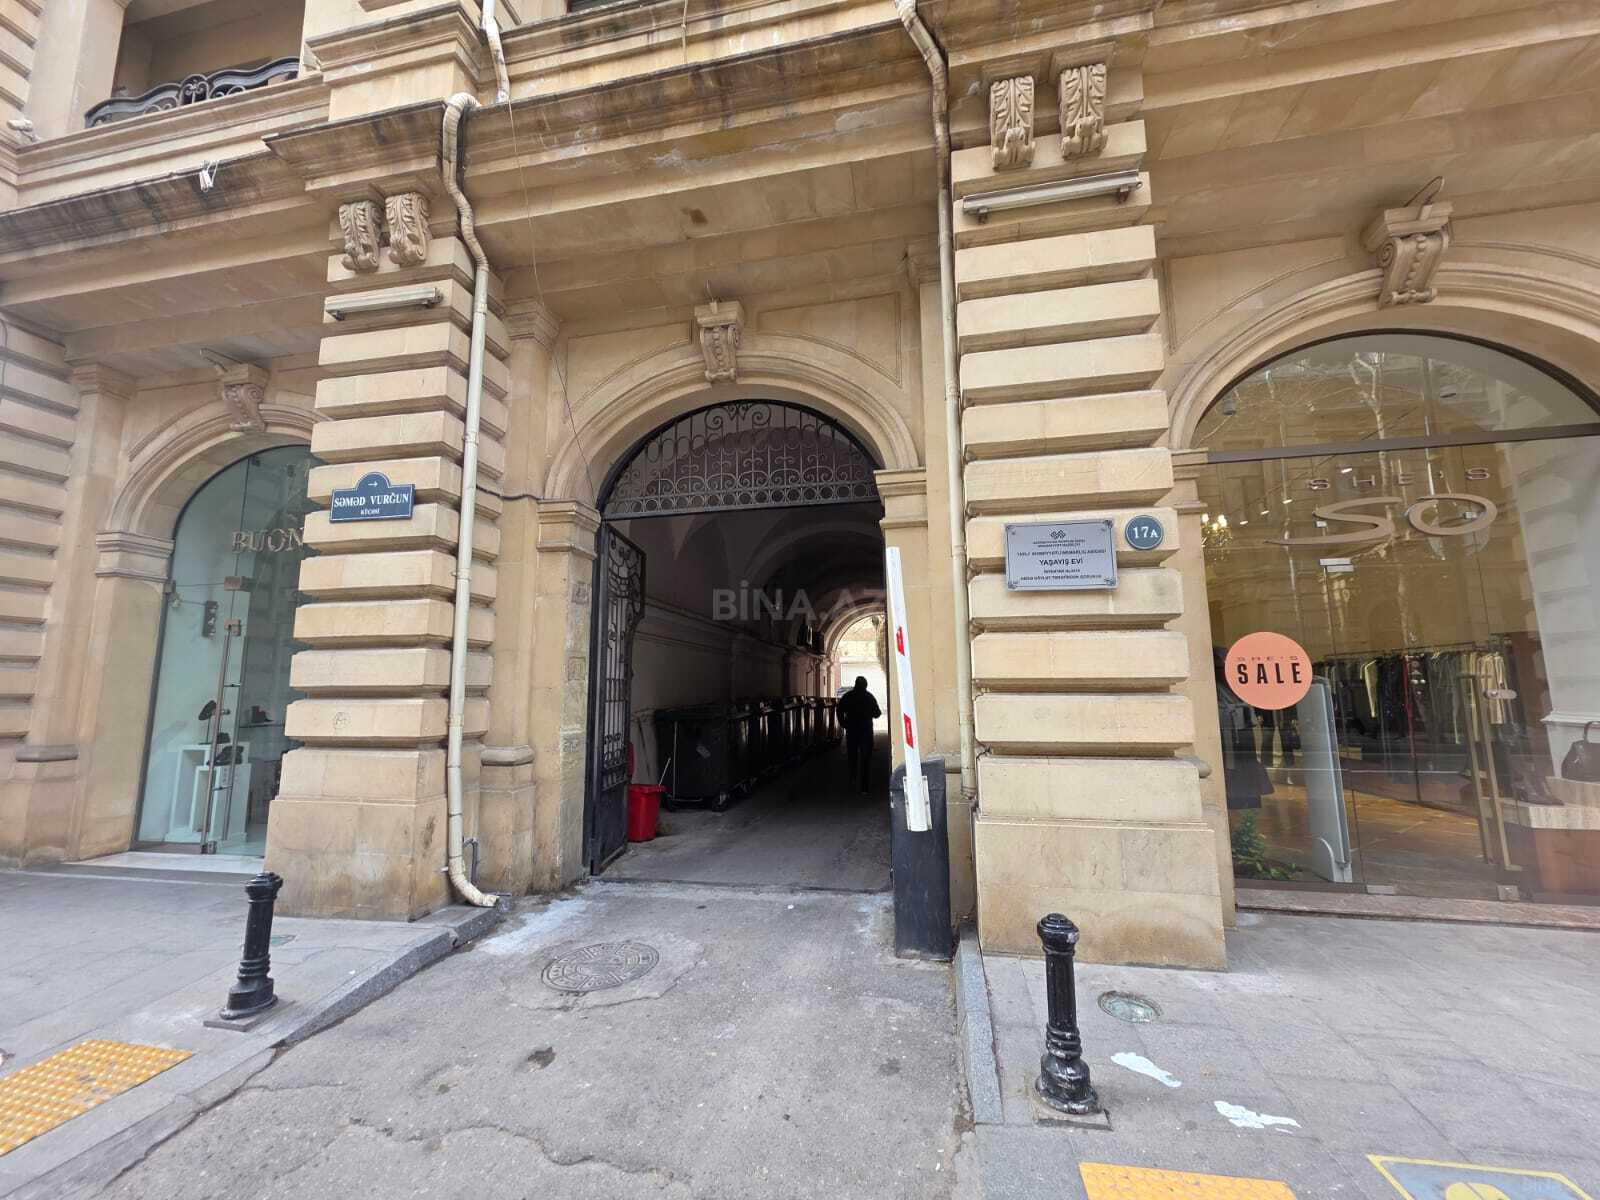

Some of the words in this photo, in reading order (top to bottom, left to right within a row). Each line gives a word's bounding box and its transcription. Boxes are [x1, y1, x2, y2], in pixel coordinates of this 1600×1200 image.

[1308, 467, 1490, 490] SHE'S
[334, 496, 366, 508] SƏMƏD
[370, 492, 409, 505] VURĞUN
[1263, 493, 1497, 545] SO
[1132, 526, 1159, 539] 17A
[1237, 662, 1302, 685] SALE
